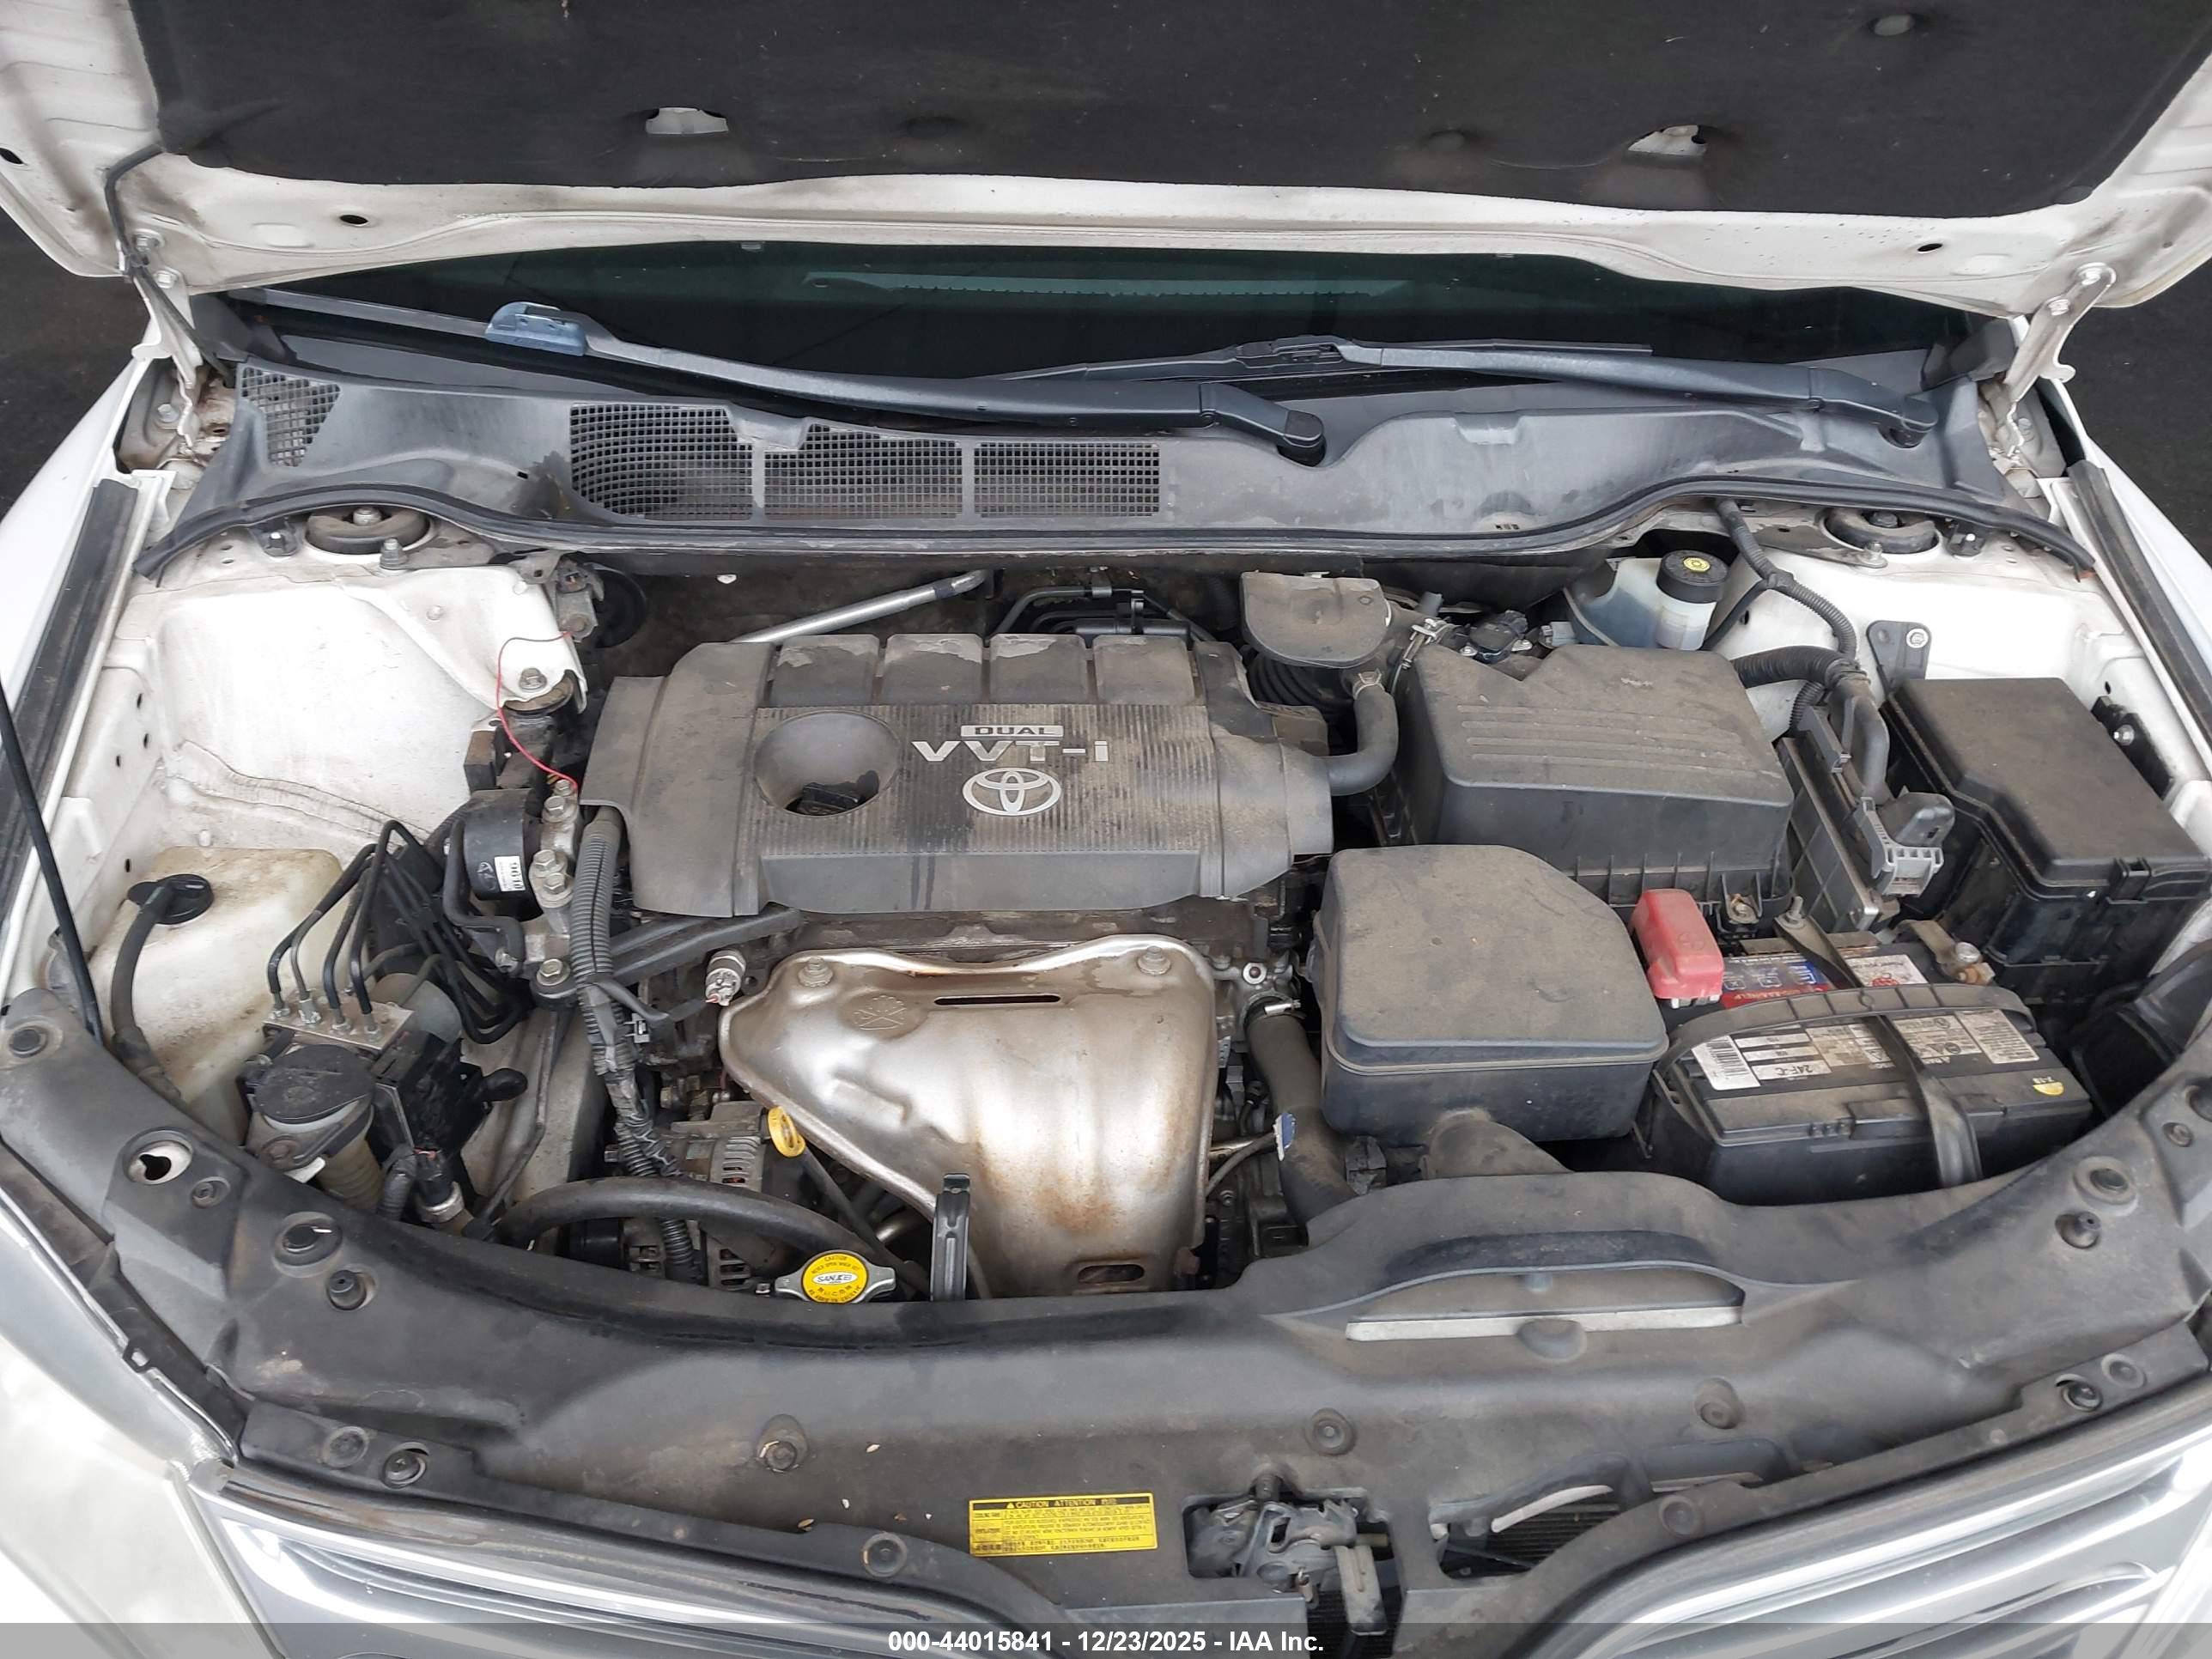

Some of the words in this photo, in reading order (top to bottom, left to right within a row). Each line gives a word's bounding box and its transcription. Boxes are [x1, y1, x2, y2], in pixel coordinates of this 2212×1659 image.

[975, 726, 1050, 735] DUAL
[912, 740, 1109, 762] VVT-i
[1775, 1065, 1814, 1076] 24F-C
[1016, 1499, 1048, 1509] CAUTION
[1054, 1498, 1096, 1507] ATTENTION
